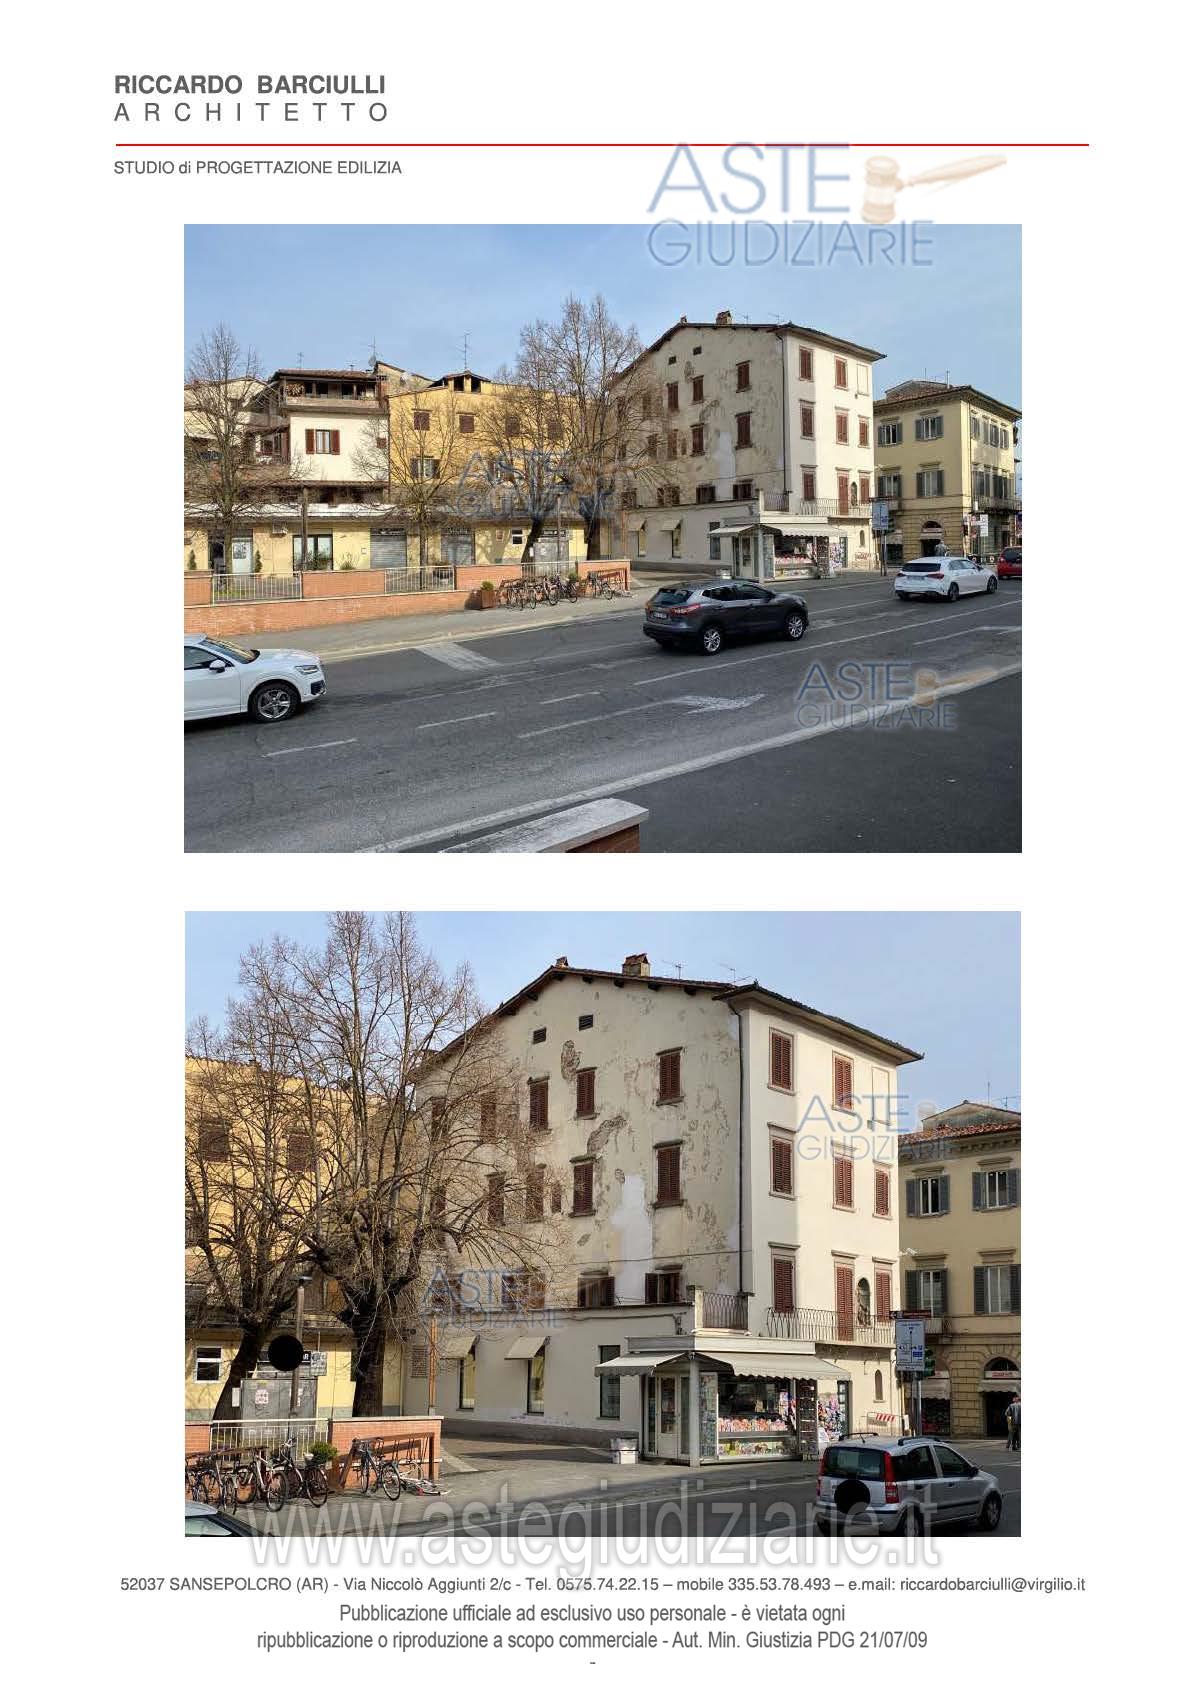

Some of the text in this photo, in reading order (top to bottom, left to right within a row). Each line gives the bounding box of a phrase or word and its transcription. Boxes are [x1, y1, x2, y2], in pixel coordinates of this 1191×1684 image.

[114, 75, 385, 95] RICCARDO BARCIULLI
[113, 160, 402, 175] STUDIO di PROGETTAZIONE EDILIZIA
[120, 1577, 165, 1591] 52037
[169, 1577, 292, 1591] SANSEPOLCRO
[296, 1577, 329, 1594] (AR)
[343, 1577, 367, 1591] Via
[371, 1577, 424, 1591] Niccolò
[427, 1577, 486, 1594] Aggiunti
[489, 1577, 512, 1591] 2/c
[526, 1577, 552, 1591] Tel.
[556, 1577, 659, 1591] 0575.74.22.15
[676, 1577, 724, 1591] mobile
[728, 1577, 831, 1591] 335.53.78.493
[848, 1577, 896, 1591] e.mail:
[900, 1577, 1086, 1594] riccardobarciulli@virgilio.it
